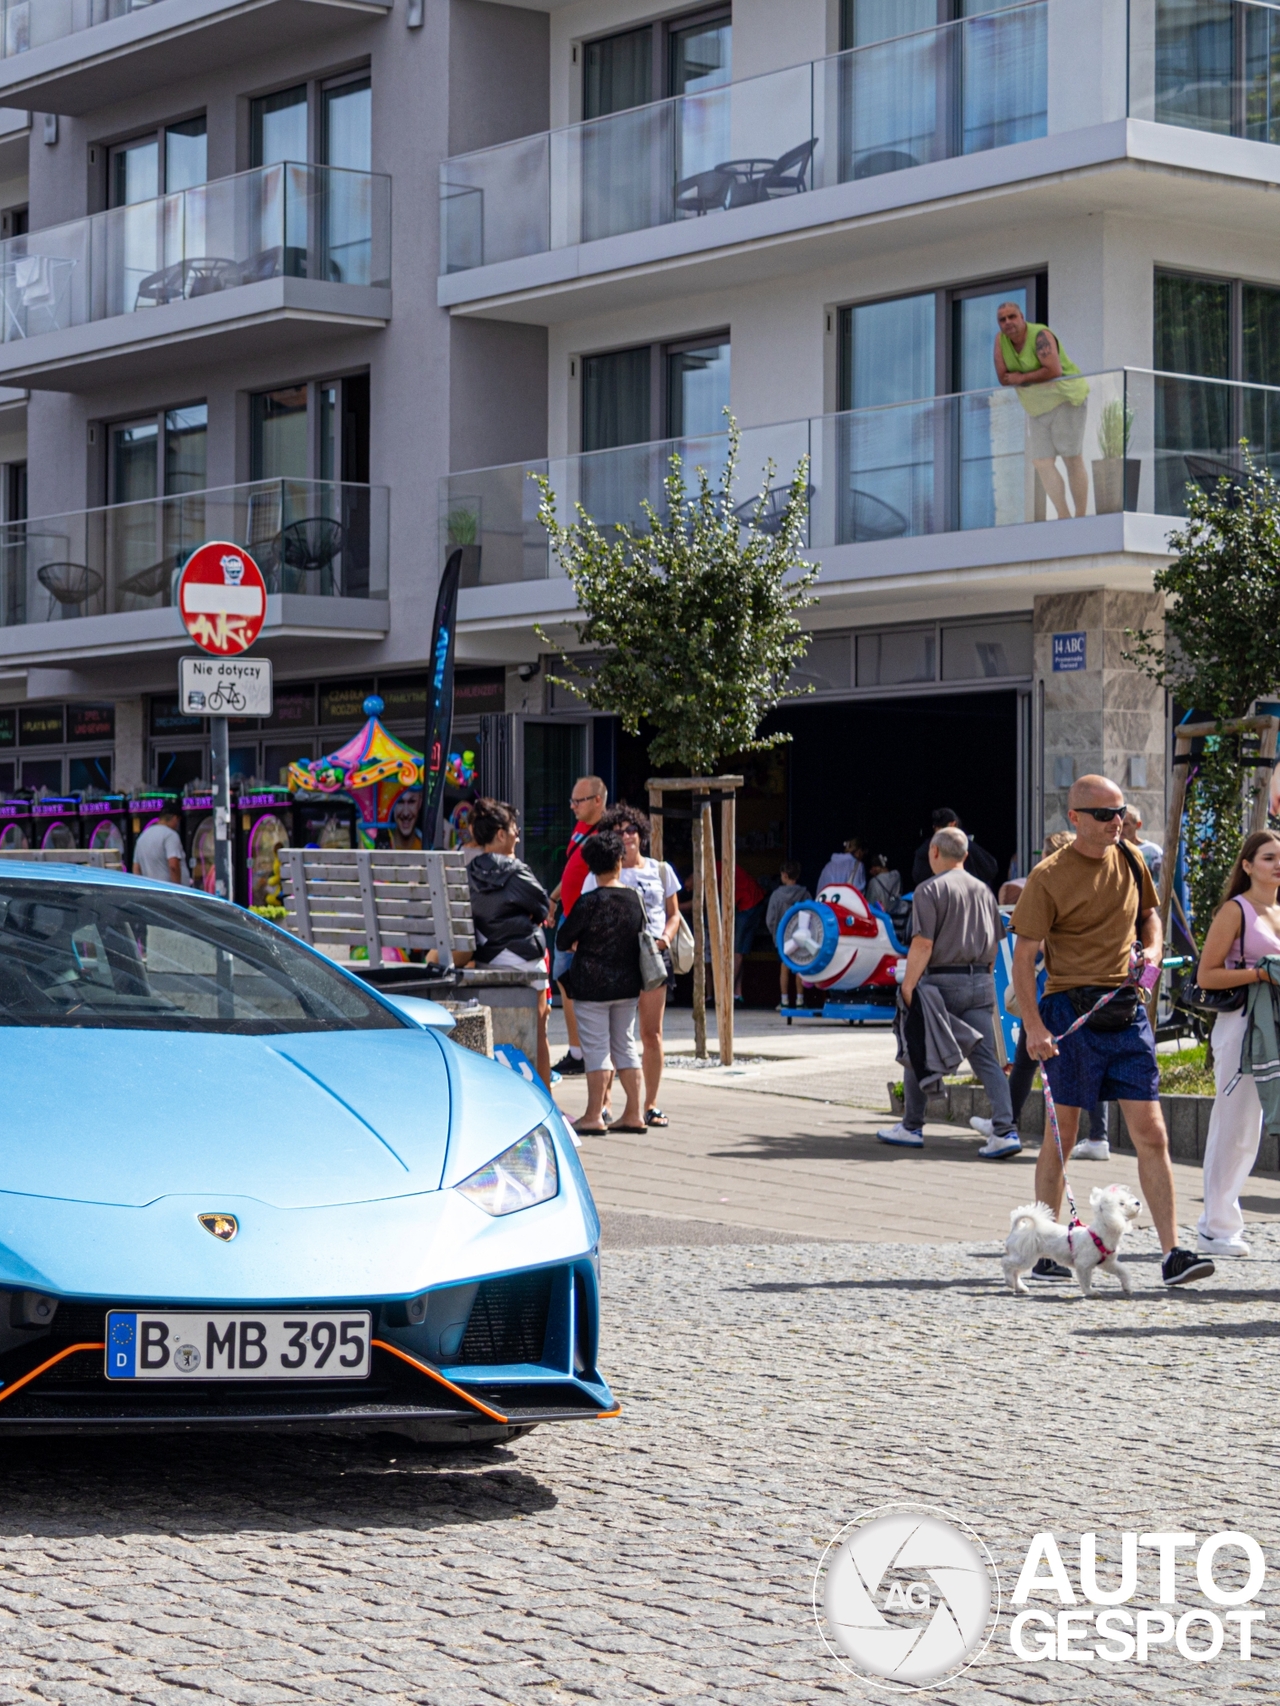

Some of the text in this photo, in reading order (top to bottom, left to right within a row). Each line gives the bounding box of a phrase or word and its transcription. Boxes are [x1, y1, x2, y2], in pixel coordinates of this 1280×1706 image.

[1055, 637, 1084, 654] 14 ABC
[193, 663, 261, 680] Nie dotyczy
[140, 1321, 170, 1369] B
[206, 1321, 268, 1369] MB
[280, 1321, 365, 1369] 395
[116, 1353, 127, 1367] D
